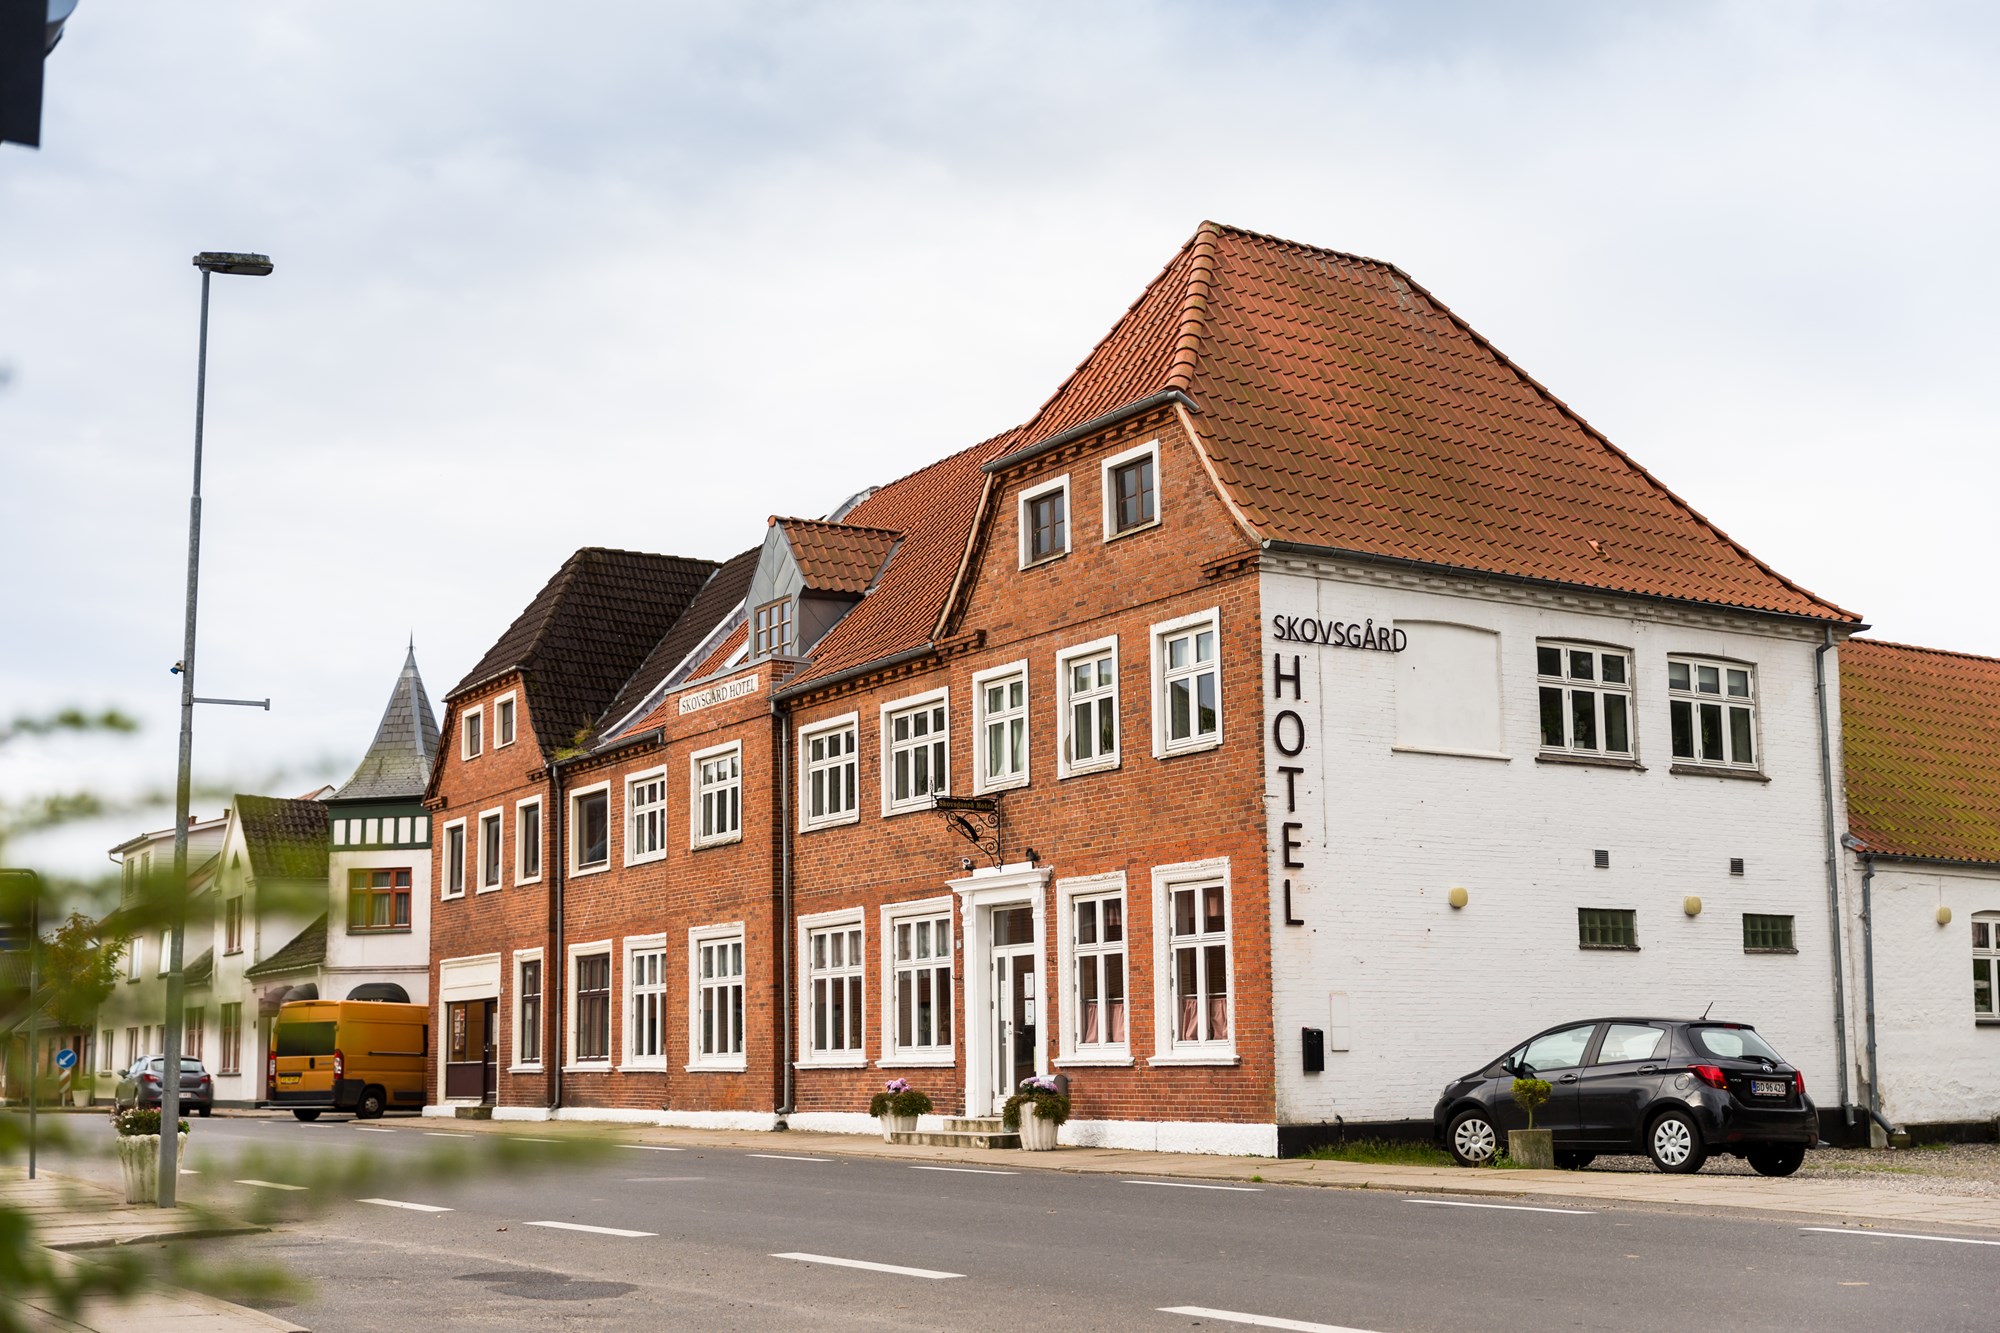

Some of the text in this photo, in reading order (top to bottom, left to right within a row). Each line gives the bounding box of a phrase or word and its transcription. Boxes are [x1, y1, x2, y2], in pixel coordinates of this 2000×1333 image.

[1273, 614, 1407, 652] SKOVSGÅRD
[681, 678, 755, 713] SKOVSGÅRD HOTEL
[976, 801, 994, 810] Hotel
[1273, 653, 1305, 926] HOTEL
[1756, 1082, 1765, 1091] BD
[1774, 1083, 1785, 1093] 420
